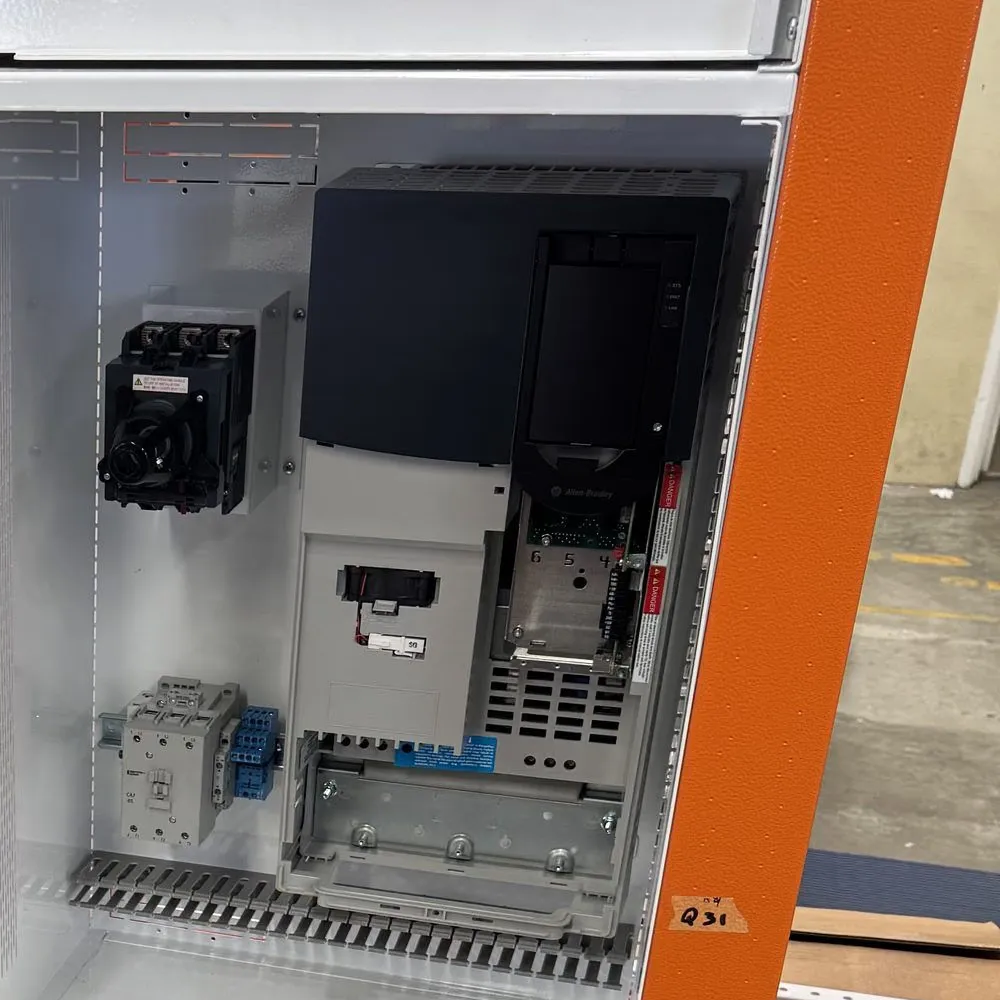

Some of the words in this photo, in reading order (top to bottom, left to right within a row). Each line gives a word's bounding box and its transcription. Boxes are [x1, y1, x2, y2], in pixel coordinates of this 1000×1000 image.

[565, 487, 613, 500] Allen-Bradley
[665, 479, 675, 507] DANGER
[531, 550, 541, 563] 6
[564, 552, 575, 566] 5
[599, 555, 611, 569] 4
[649, 586, 659, 613] DANGER
